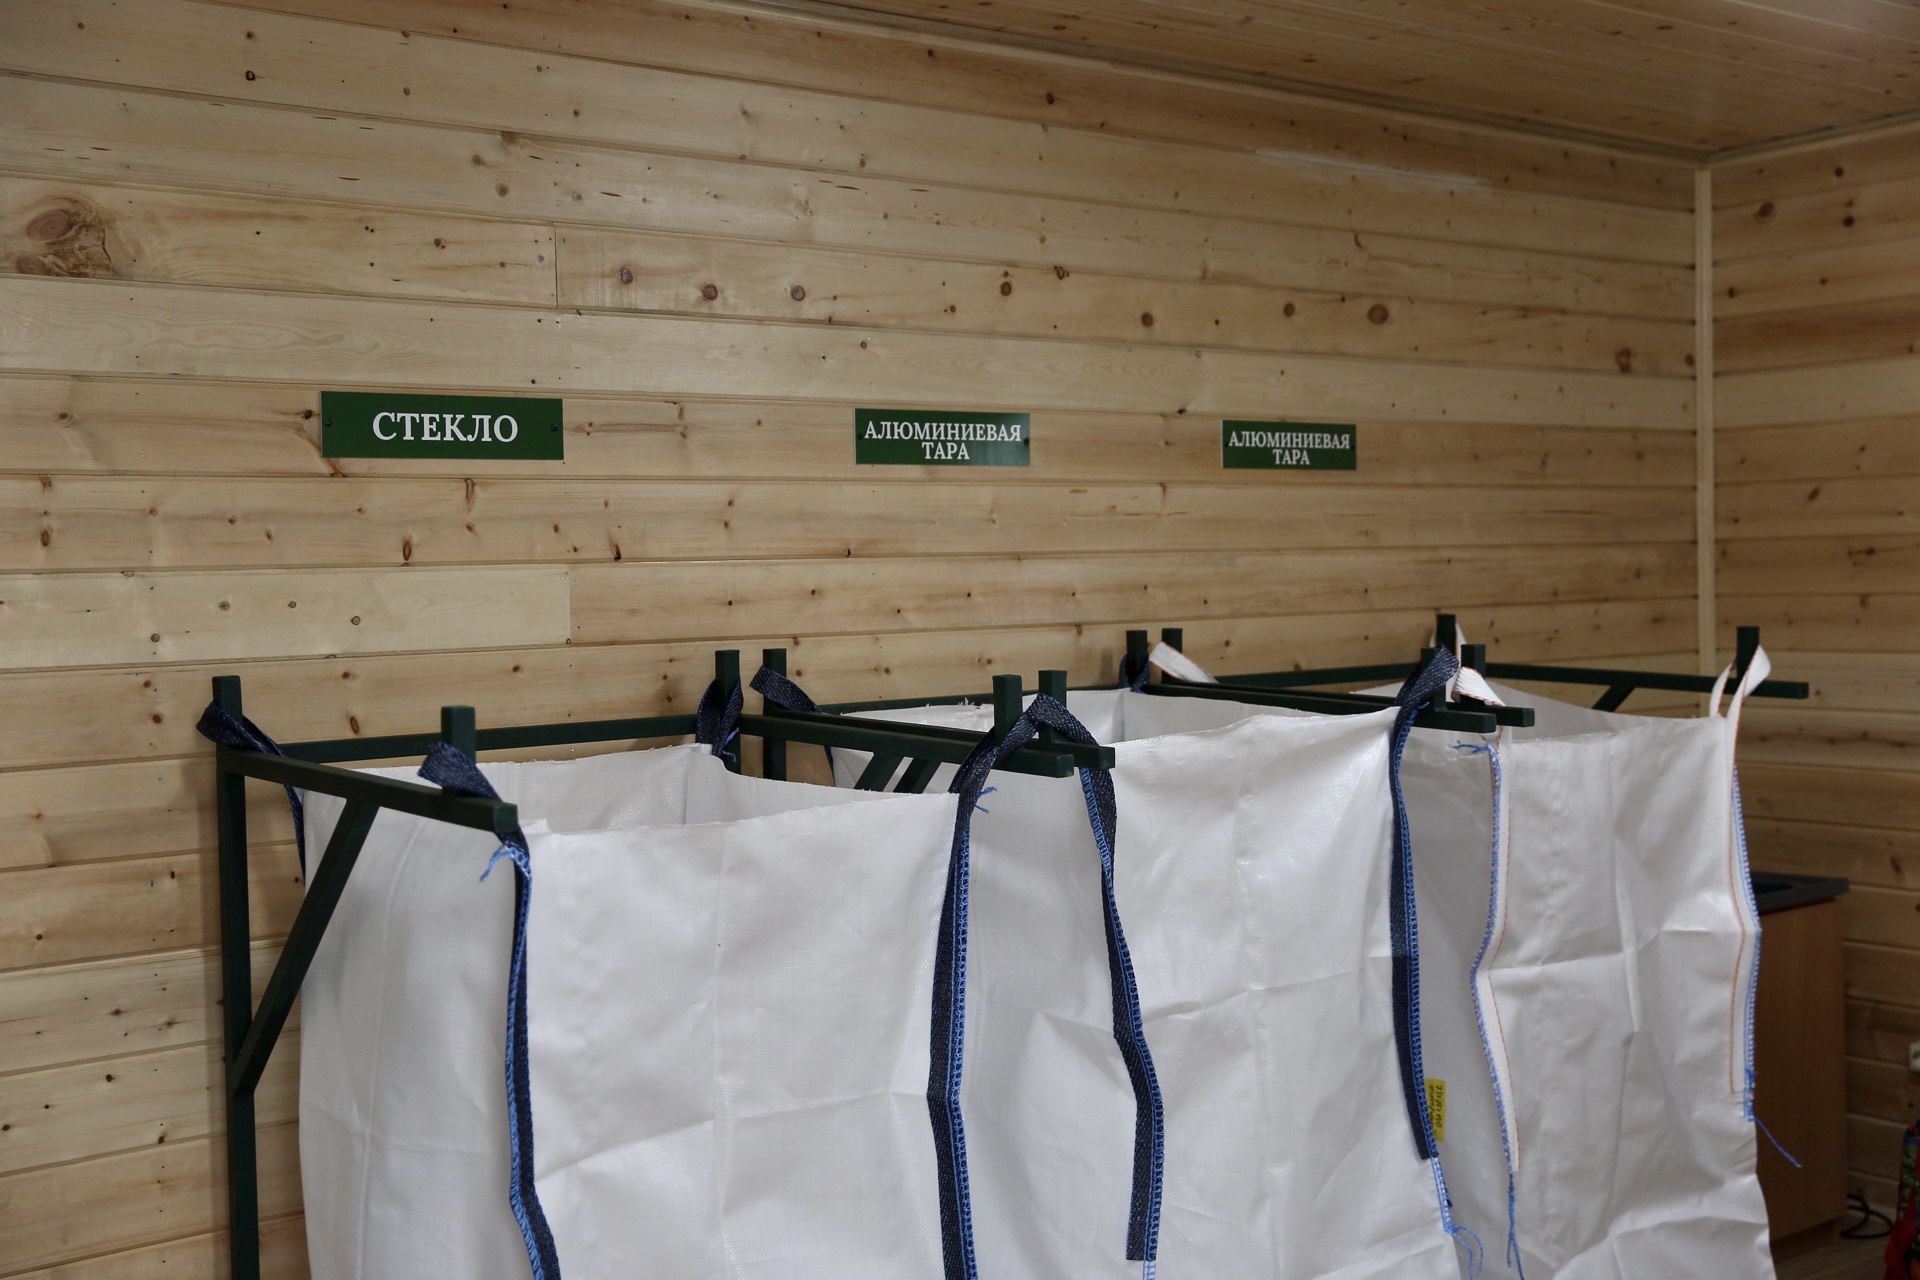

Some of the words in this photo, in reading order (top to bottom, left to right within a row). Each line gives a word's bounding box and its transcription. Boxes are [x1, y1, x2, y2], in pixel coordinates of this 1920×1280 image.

[372, 411, 518, 443] СТЕКЛО
[864, 420, 1022, 442] АЛЮМИНИЕВАЯ
[1228, 430, 1350, 449] АЛЮМИНИЕВАЯ
[921, 442, 970, 460] ТАРА
[1272, 449, 1310, 465] ТАРА
